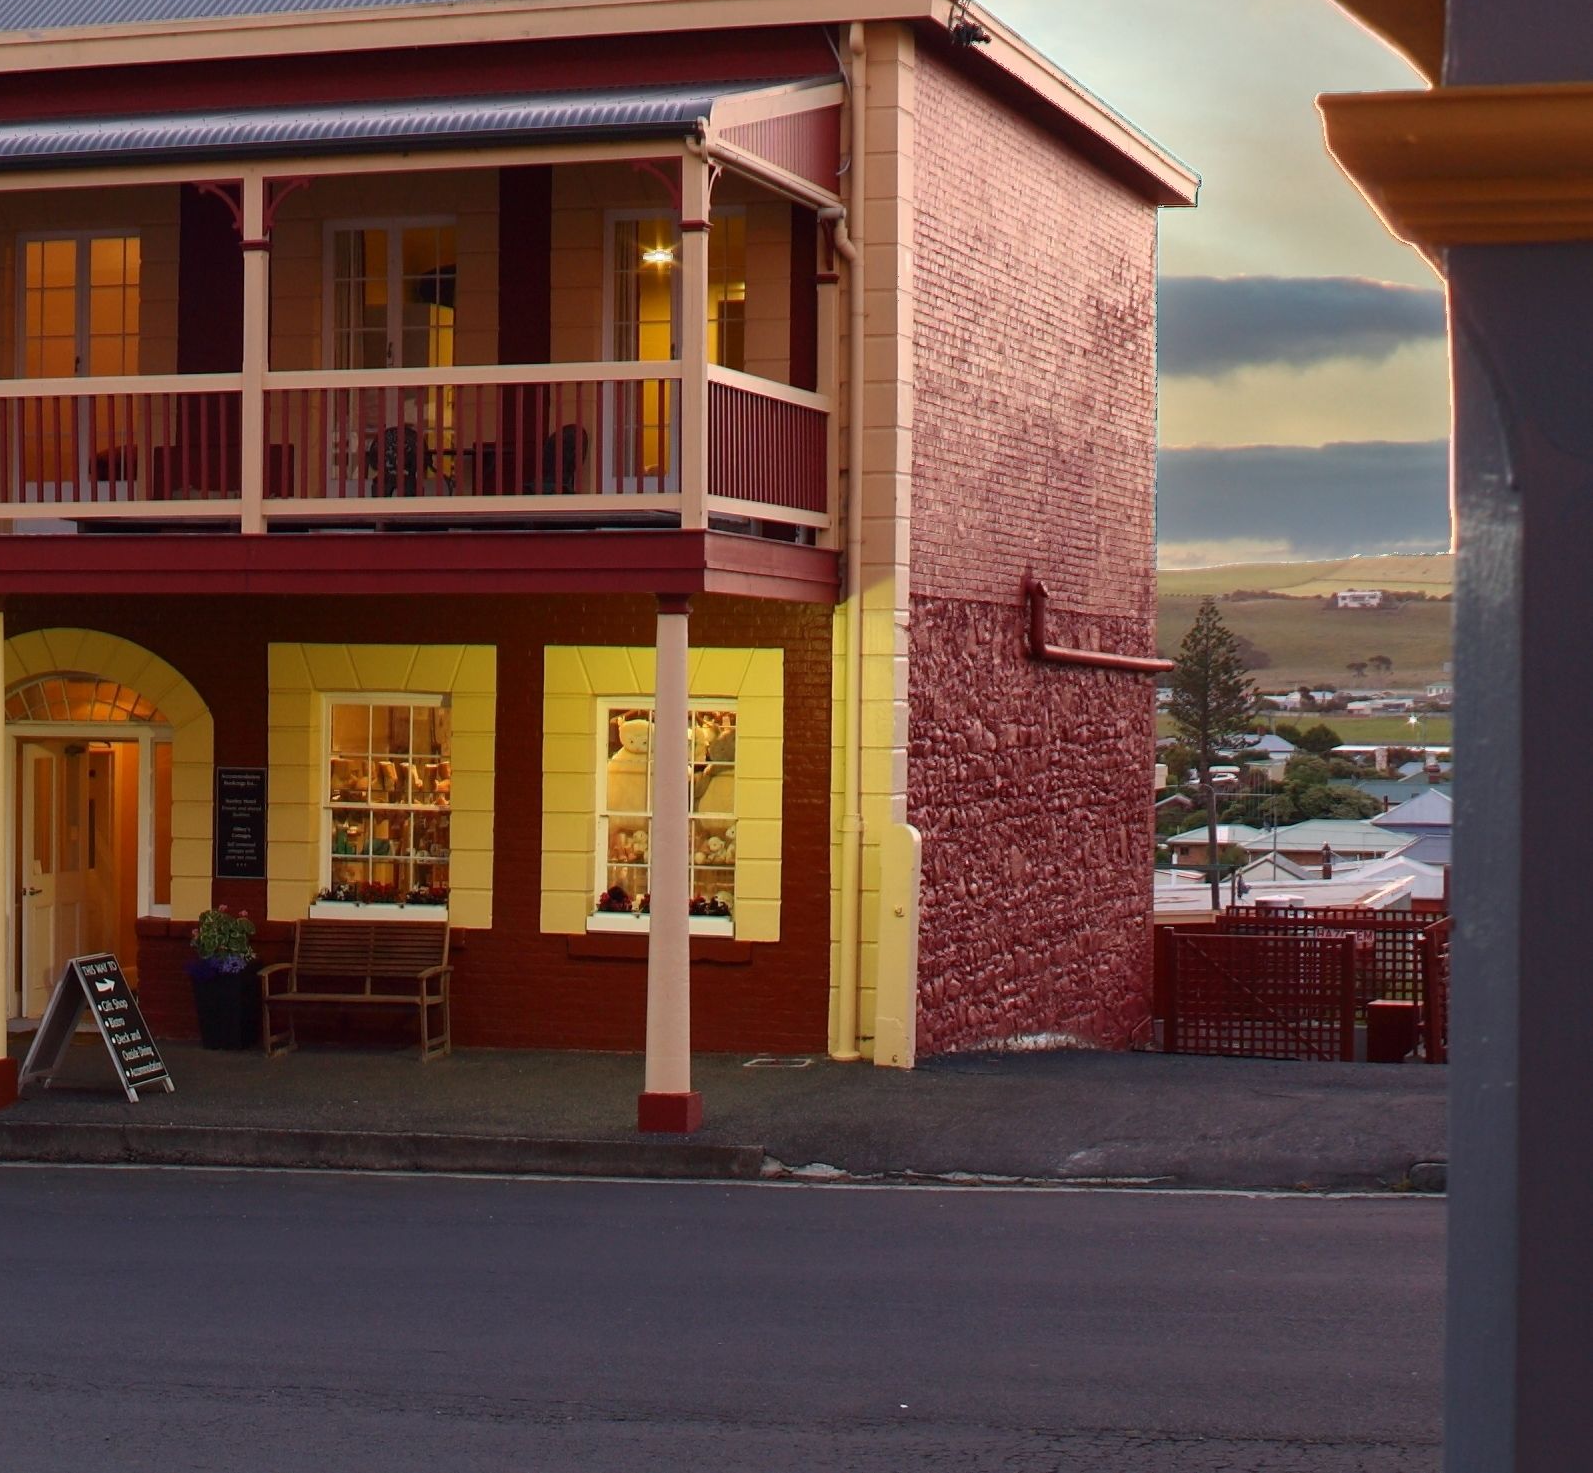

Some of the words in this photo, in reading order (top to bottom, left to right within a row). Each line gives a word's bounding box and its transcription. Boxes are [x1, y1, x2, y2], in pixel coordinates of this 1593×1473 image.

[1316, 928, 1374, 942] HAZEM
[81, 964, 96, 976] THIS
[95, 962, 108, 974] WAY
[107, 960, 118, 972] TO
[112, 998, 128, 1010] Shop
[130, 1028, 141, 1041] and
